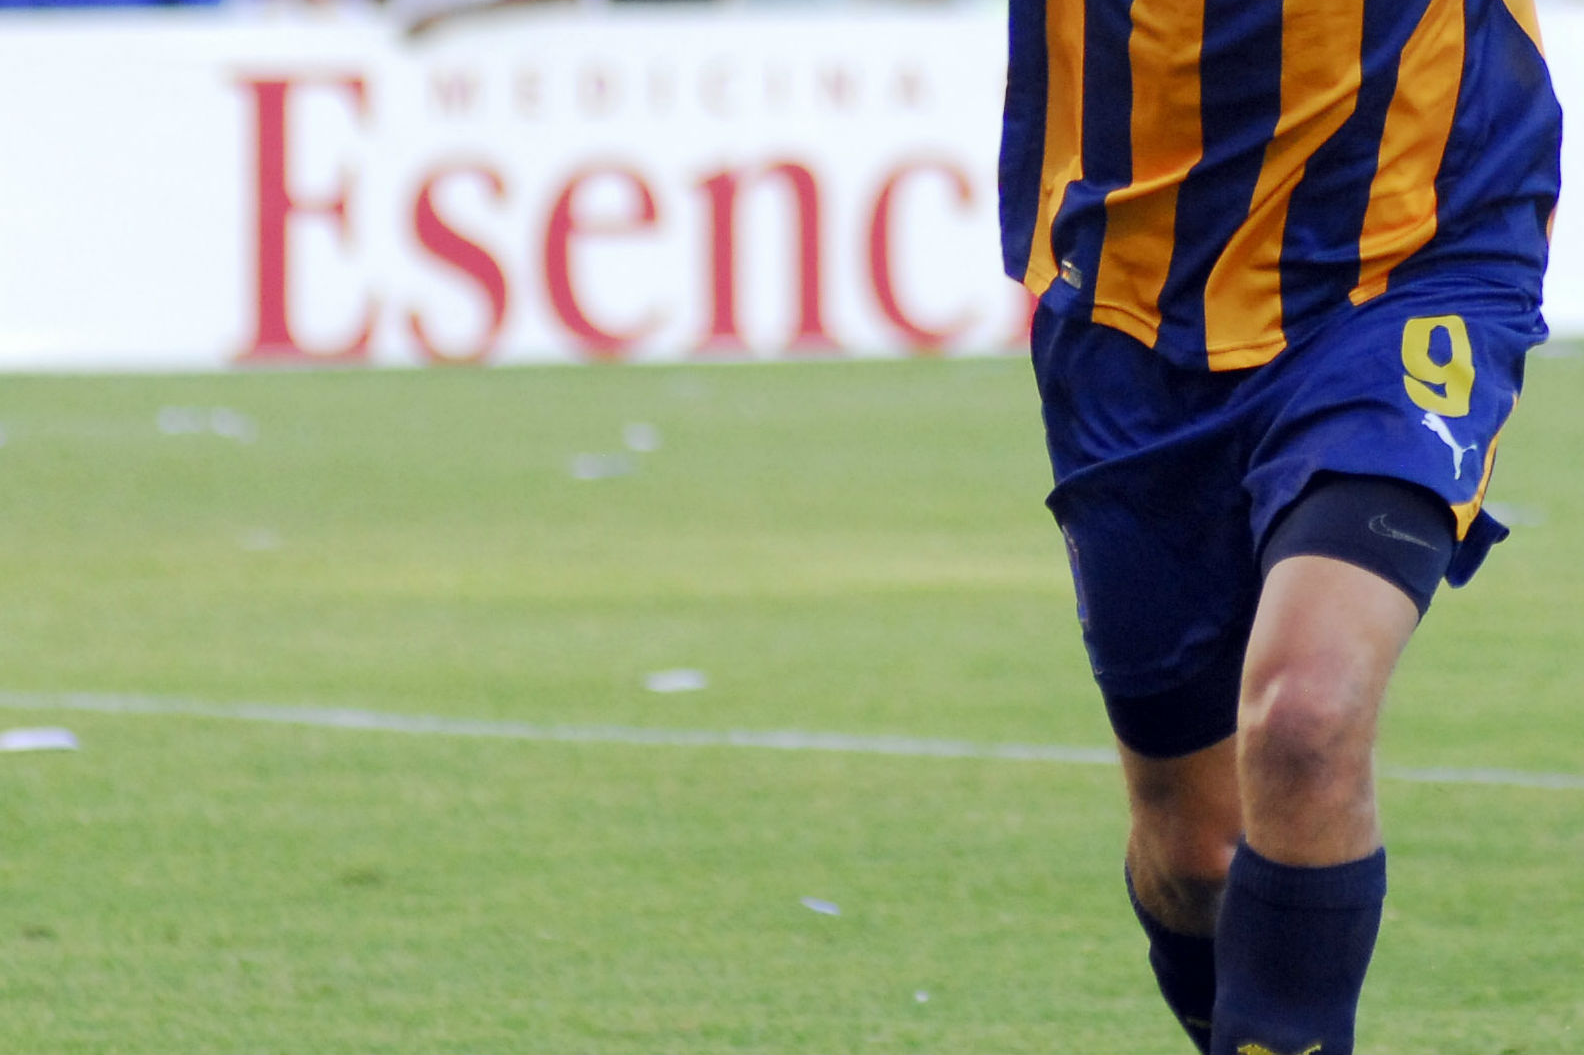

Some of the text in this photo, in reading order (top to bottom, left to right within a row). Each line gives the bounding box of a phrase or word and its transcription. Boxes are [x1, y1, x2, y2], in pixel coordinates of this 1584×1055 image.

[430, 65, 932, 119] MEDICINA
[232, 72, 1037, 361] Esenc
[1402, 314, 1475, 417] 9
